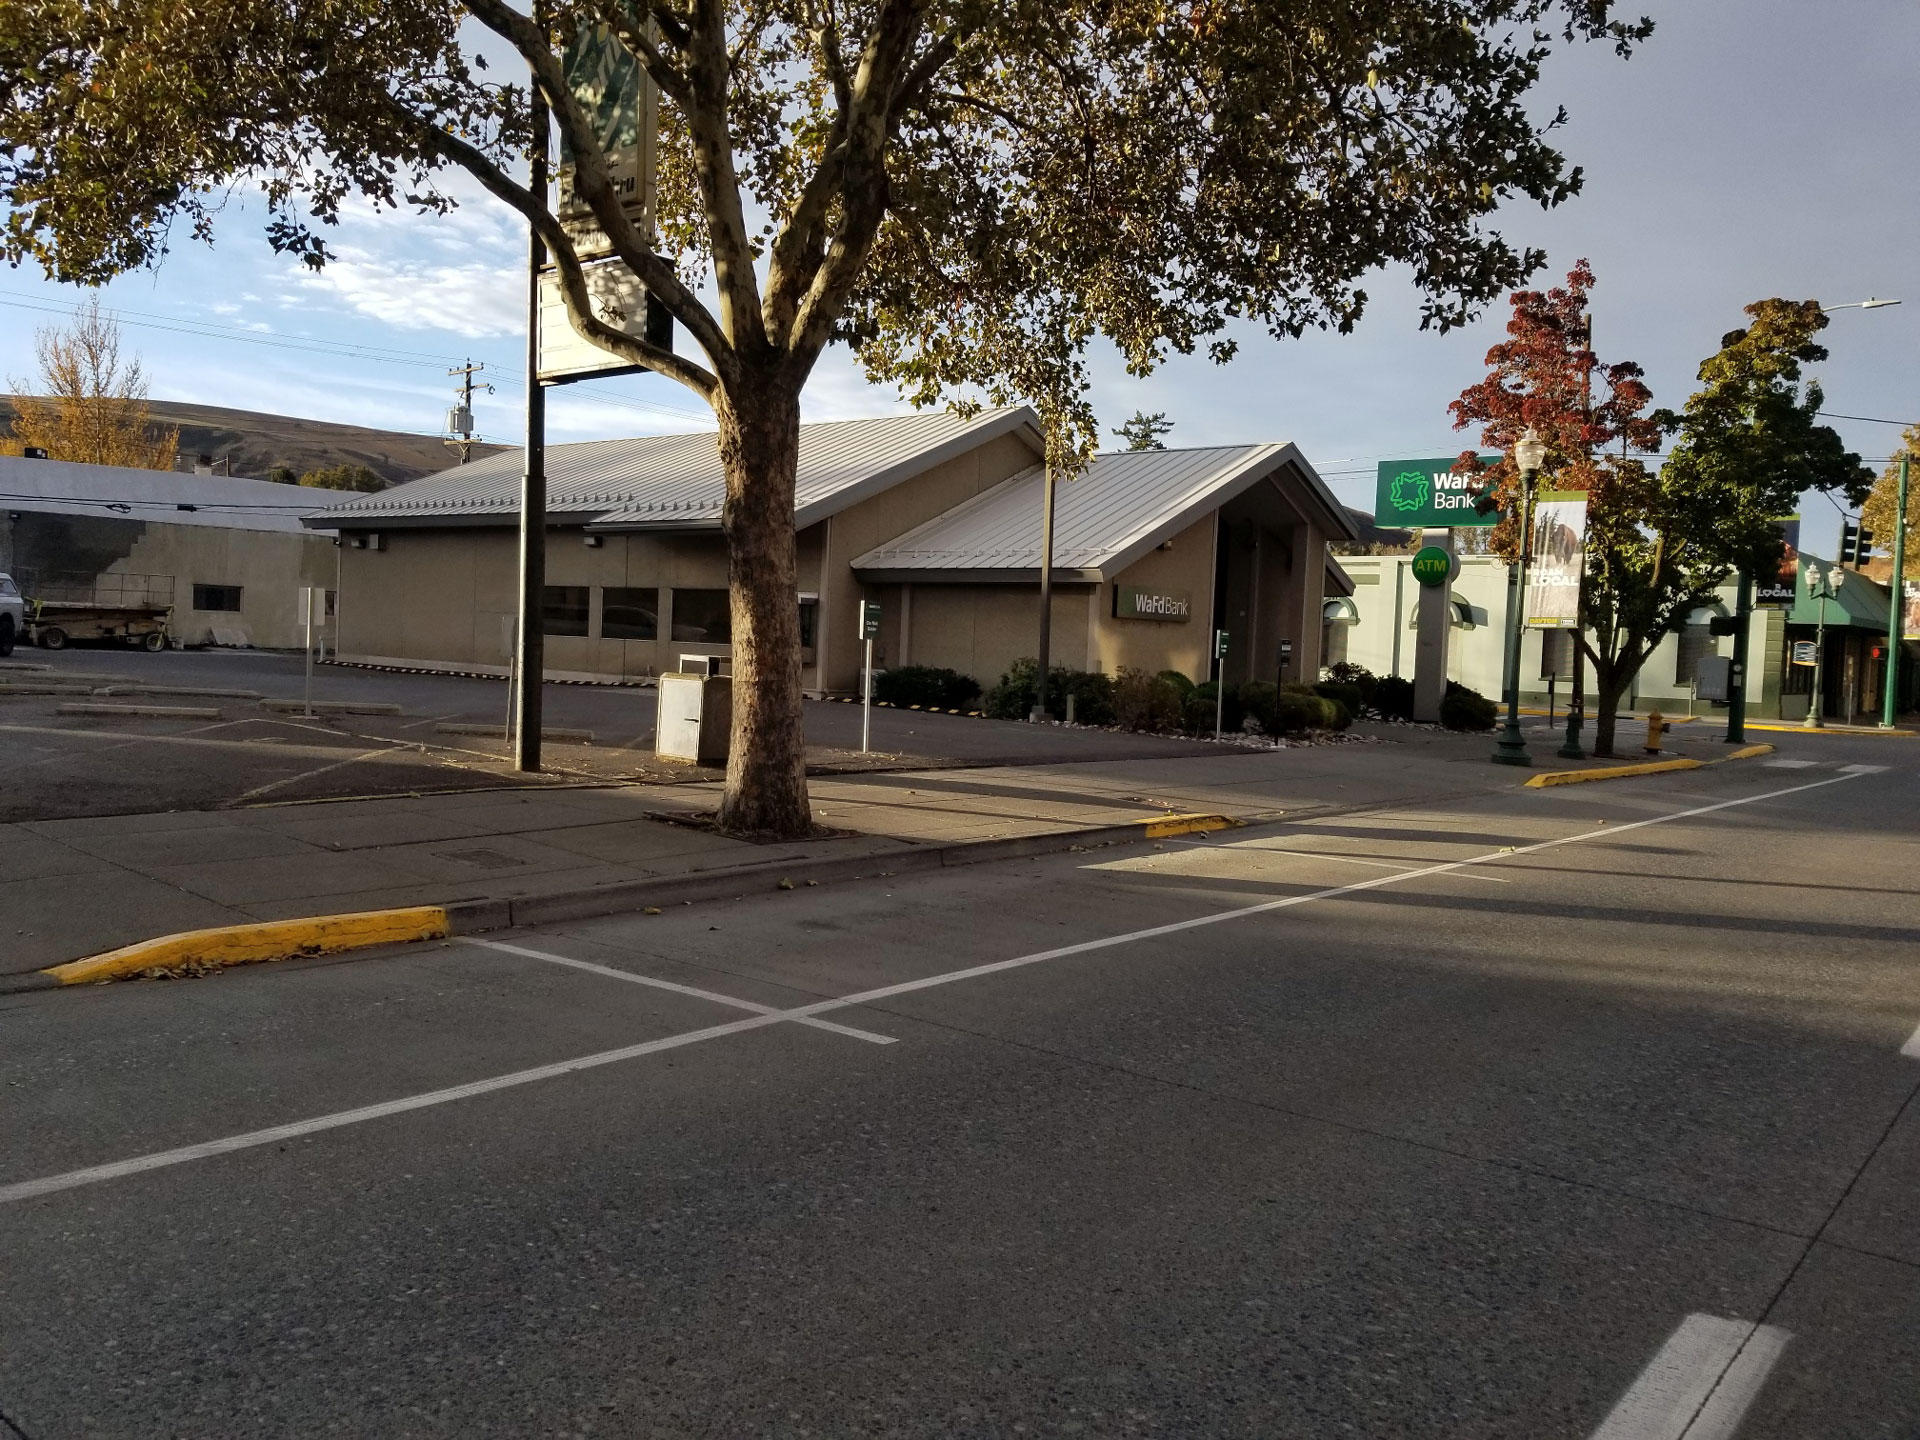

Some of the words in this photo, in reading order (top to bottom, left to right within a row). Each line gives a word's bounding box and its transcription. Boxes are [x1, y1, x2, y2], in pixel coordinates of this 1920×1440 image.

[1434, 492, 1476, 509] Bank
[1416, 560, 1447, 571] ATM
[1532, 576, 1579, 587] LOCAL
[1757, 589, 1795, 597] LOCAL
